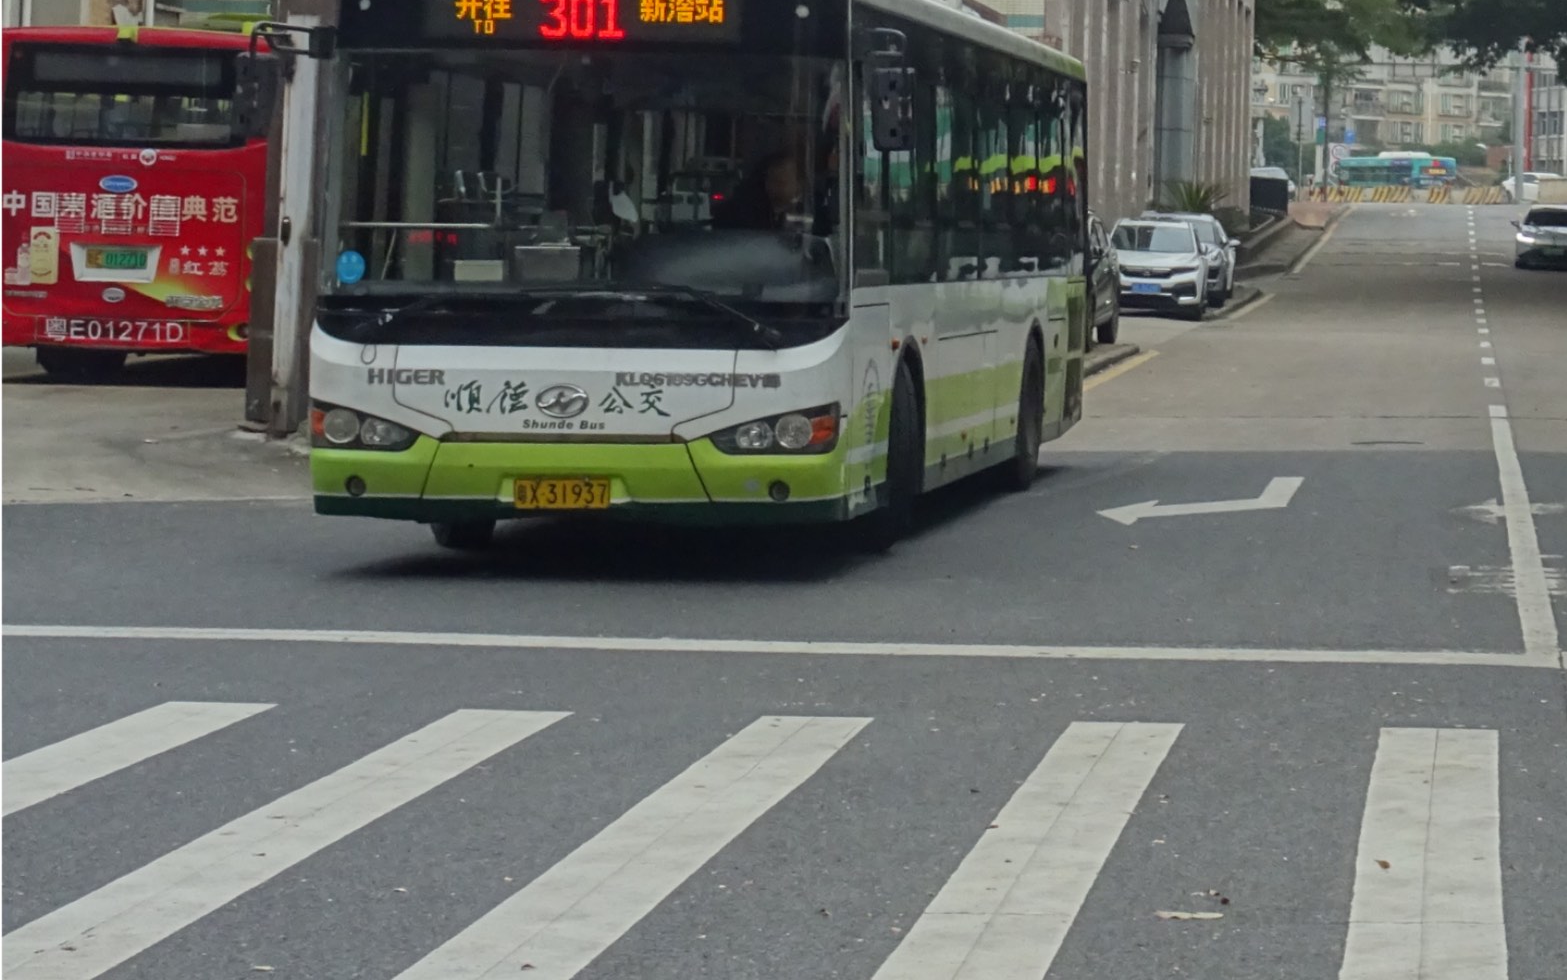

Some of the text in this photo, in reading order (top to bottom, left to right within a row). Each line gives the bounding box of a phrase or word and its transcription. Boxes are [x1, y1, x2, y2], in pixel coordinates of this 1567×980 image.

[474, 20, 494, 34] TO
[46, 316, 184, 342] 粤E01271D
[367, 368, 445, 386] HIGER
[598, 384, 671, 418] 公交
[522, 419, 606, 430] Shunde Bus
